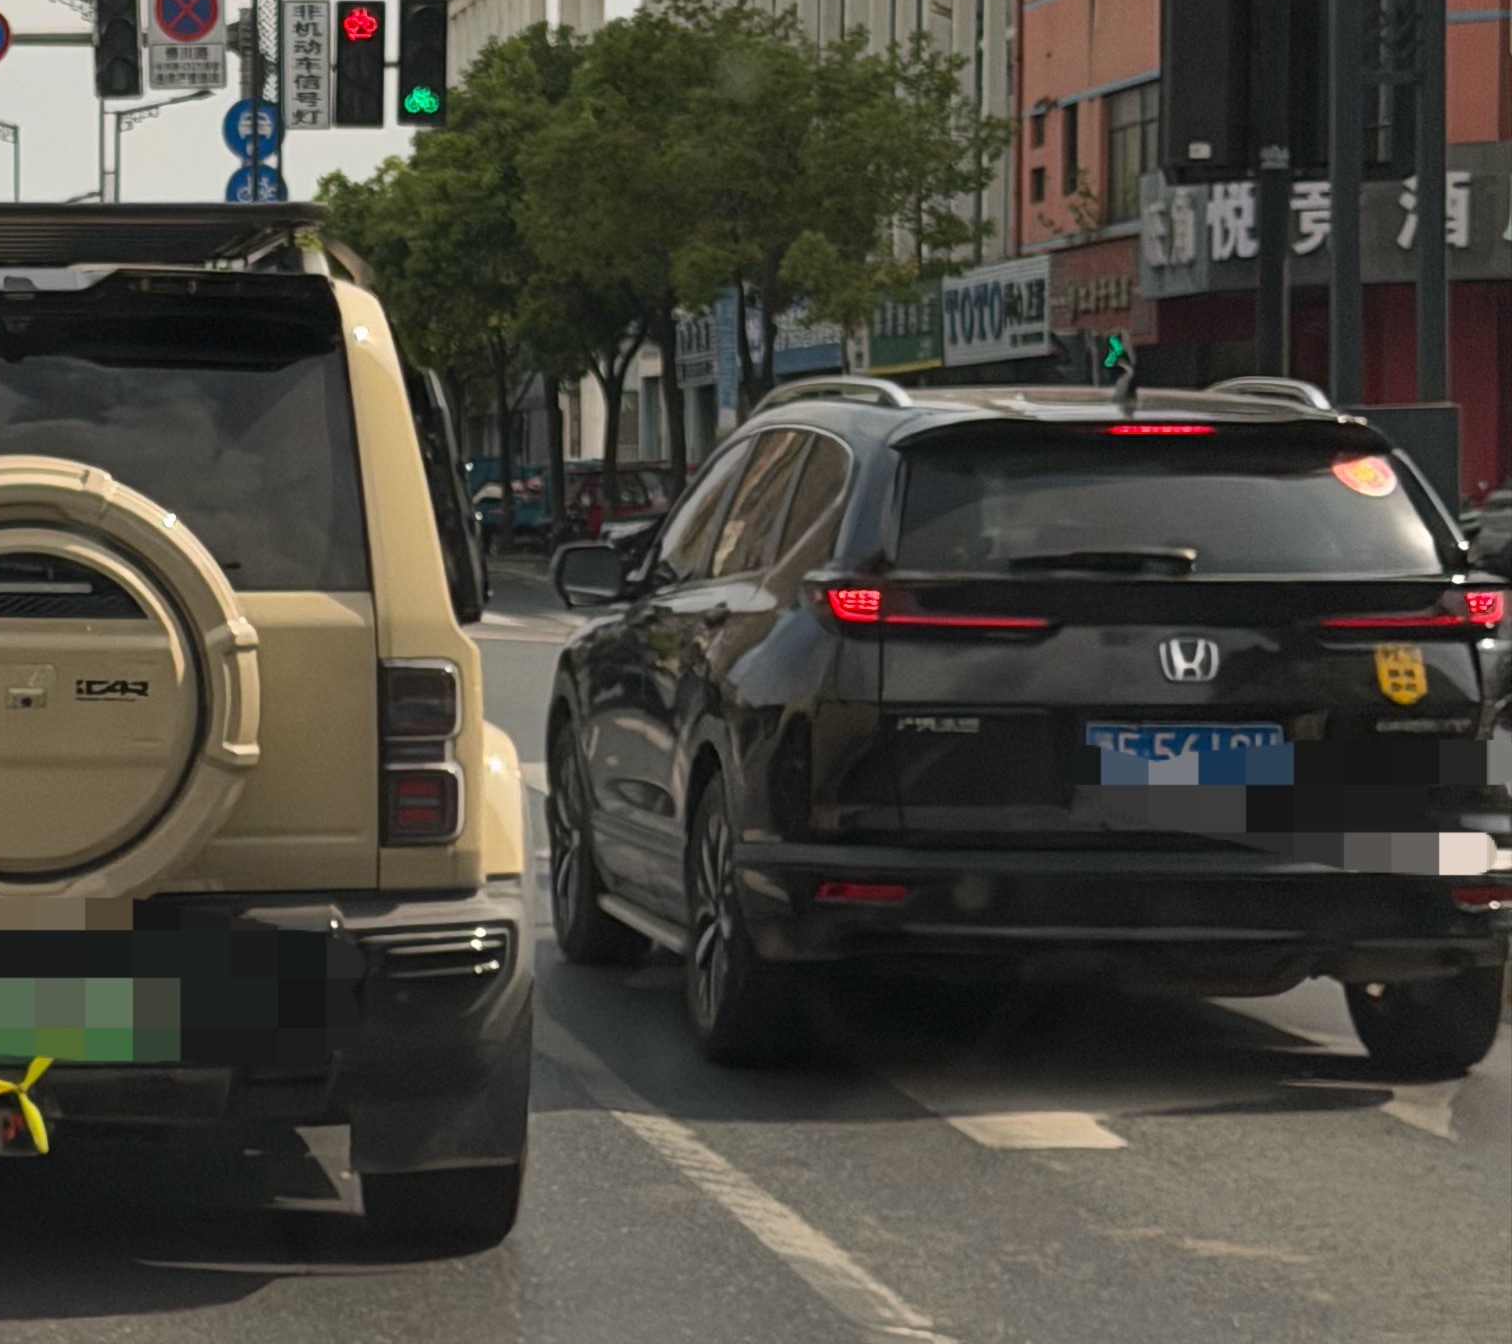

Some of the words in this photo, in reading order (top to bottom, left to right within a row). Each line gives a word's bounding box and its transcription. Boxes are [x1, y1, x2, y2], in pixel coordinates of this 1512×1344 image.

[292, 4, 324, 126] 非机动车信号灯
[1206, 170, 1512, 261] 悦竞酒
[944, 281, 1003, 346] TOTO
